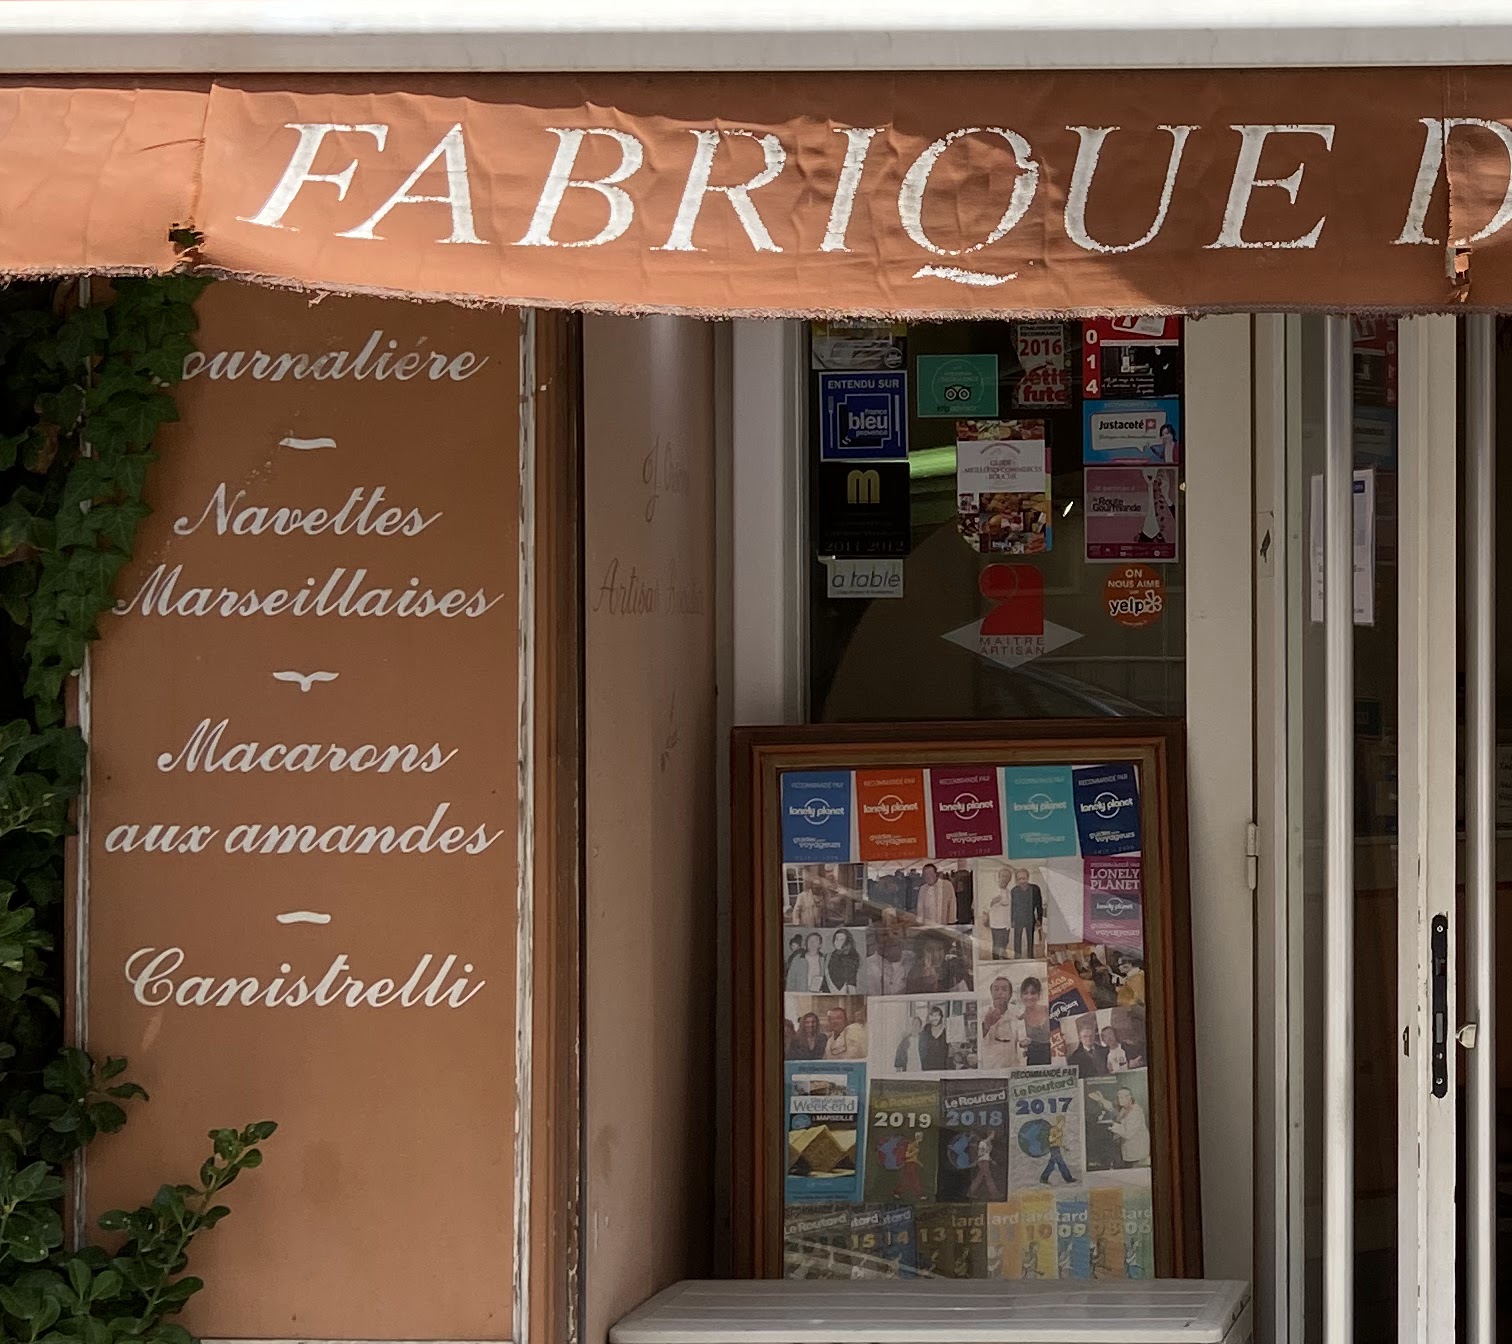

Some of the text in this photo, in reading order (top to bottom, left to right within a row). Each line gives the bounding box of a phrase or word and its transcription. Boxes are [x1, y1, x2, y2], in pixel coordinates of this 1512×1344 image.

[235, 121, 1338, 288] FABRIQUE
[182, 330, 489, 381] ournaliére
[1019, 339, 1062, 356] 2016
[828, 380, 899, 389] ENTENDU SUR
[848, 412, 888, 430] bleu
[173, 482, 443, 537] Navettes
[851, 571, 900, 587] table
[1125, 569, 1142, 578] ON
[112, 563, 505, 618] Marseillaises
[1108, 579, 1160, 588] NOUS AIME
[1109, 597, 1145, 616] yelp
[980, 637, 1044, 645] MAITRE
[980, 646, 1045, 655] ARTISAN
[157, 718, 459, 773] Macarons
[789, 806, 844, 817] lonely planet
[863, 802, 918, 815] lonely planet
[939, 800, 993, 813] lonely planet
[1014, 801, 1066, 813] lonely planet
[1080, 798, 1133, 812] lonely planet
[105, 802, 505, 855] aux amandes
[1090, 869, 1140, 879] LONELY
[1090, 879, 1140, 890] PLANET
[124, 947, 486, 1008] Canistrelli
[1062, 1067, 1077, 1077] PAR
[1013, 1078, 1074, 1098] Le Routard
[793, 1100, 854, 1112] Week-end
[945, 1090, 1005, 1109] Le Routard
[1016, 1098, 1072, 1115] 2017
[873, 1112, 932, 1128] 2019
[946, 1110, 1003, 1127] 2018
[785, 1213, 847, 1235] Le Routard
[1058, 1224, 1087, 1238] 09
[919, 1227, 947, 1244] 13
[956, 1228, 983, 1243] 12
[1026, 1224, 1052, 1241] 10
[852, 1233, 875, 1249] 15
